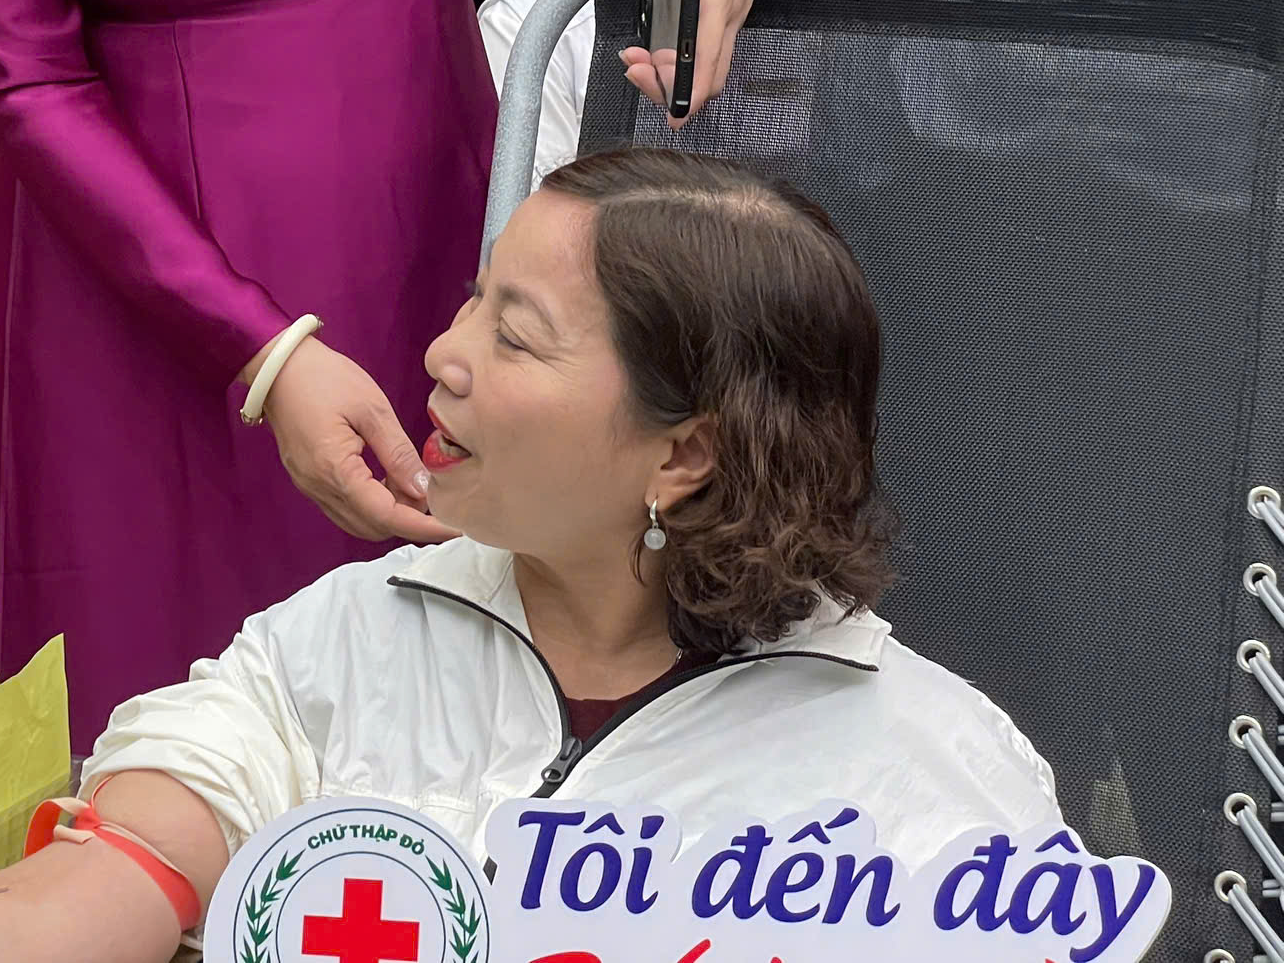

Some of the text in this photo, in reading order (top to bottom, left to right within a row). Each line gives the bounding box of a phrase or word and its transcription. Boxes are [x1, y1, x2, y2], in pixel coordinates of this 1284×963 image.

[307, 823, 426, 856] CHỮ THẬP ĐỎ
[518, 807, 1156, 963] Tôi đến đây
